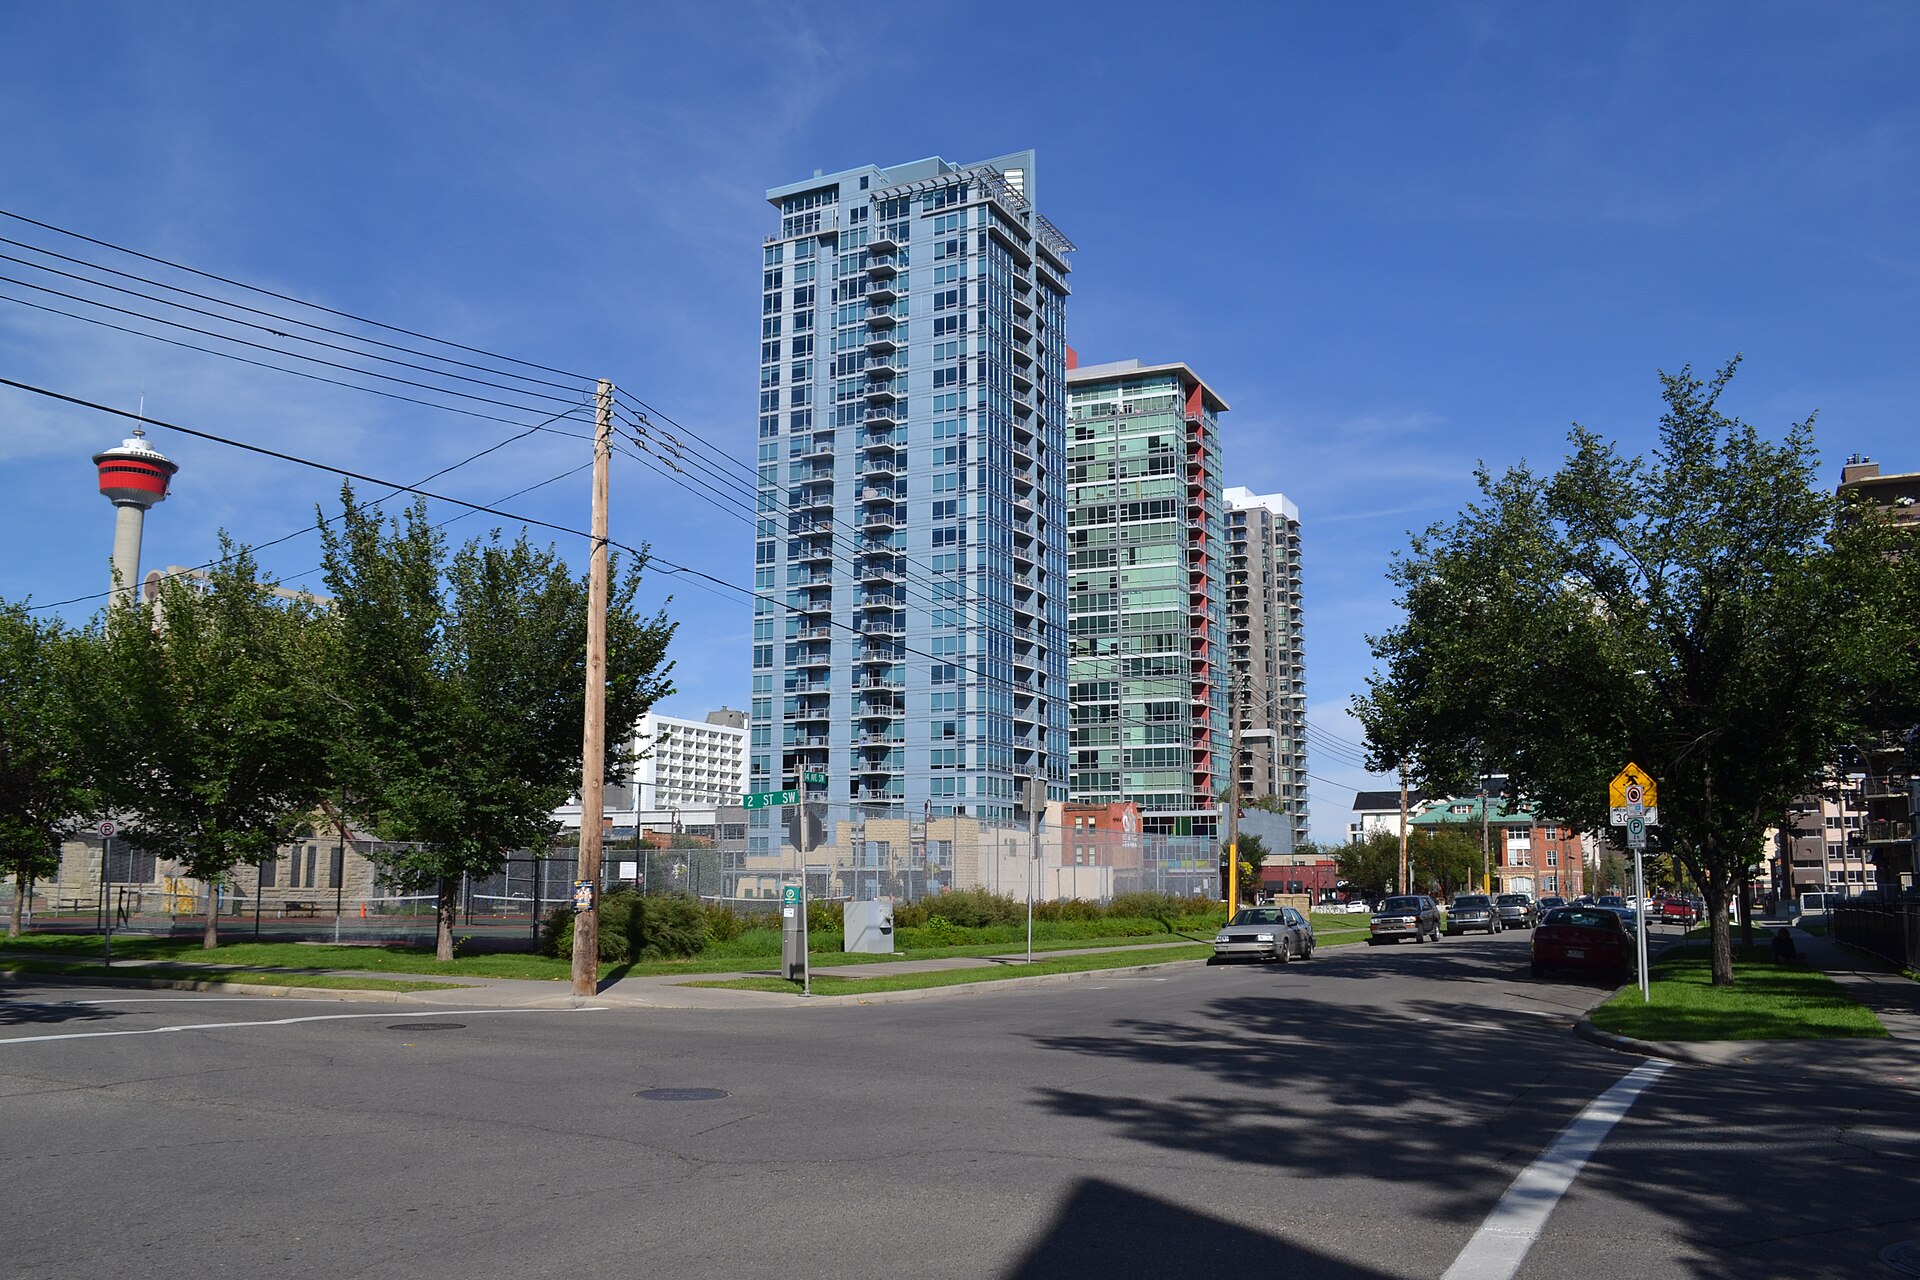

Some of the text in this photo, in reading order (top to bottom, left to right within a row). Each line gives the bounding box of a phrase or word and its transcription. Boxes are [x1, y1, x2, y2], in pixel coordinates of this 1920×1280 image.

[747, 791, 796, 807] 2 ST SW
[1633, 822, 1640, 831] P
